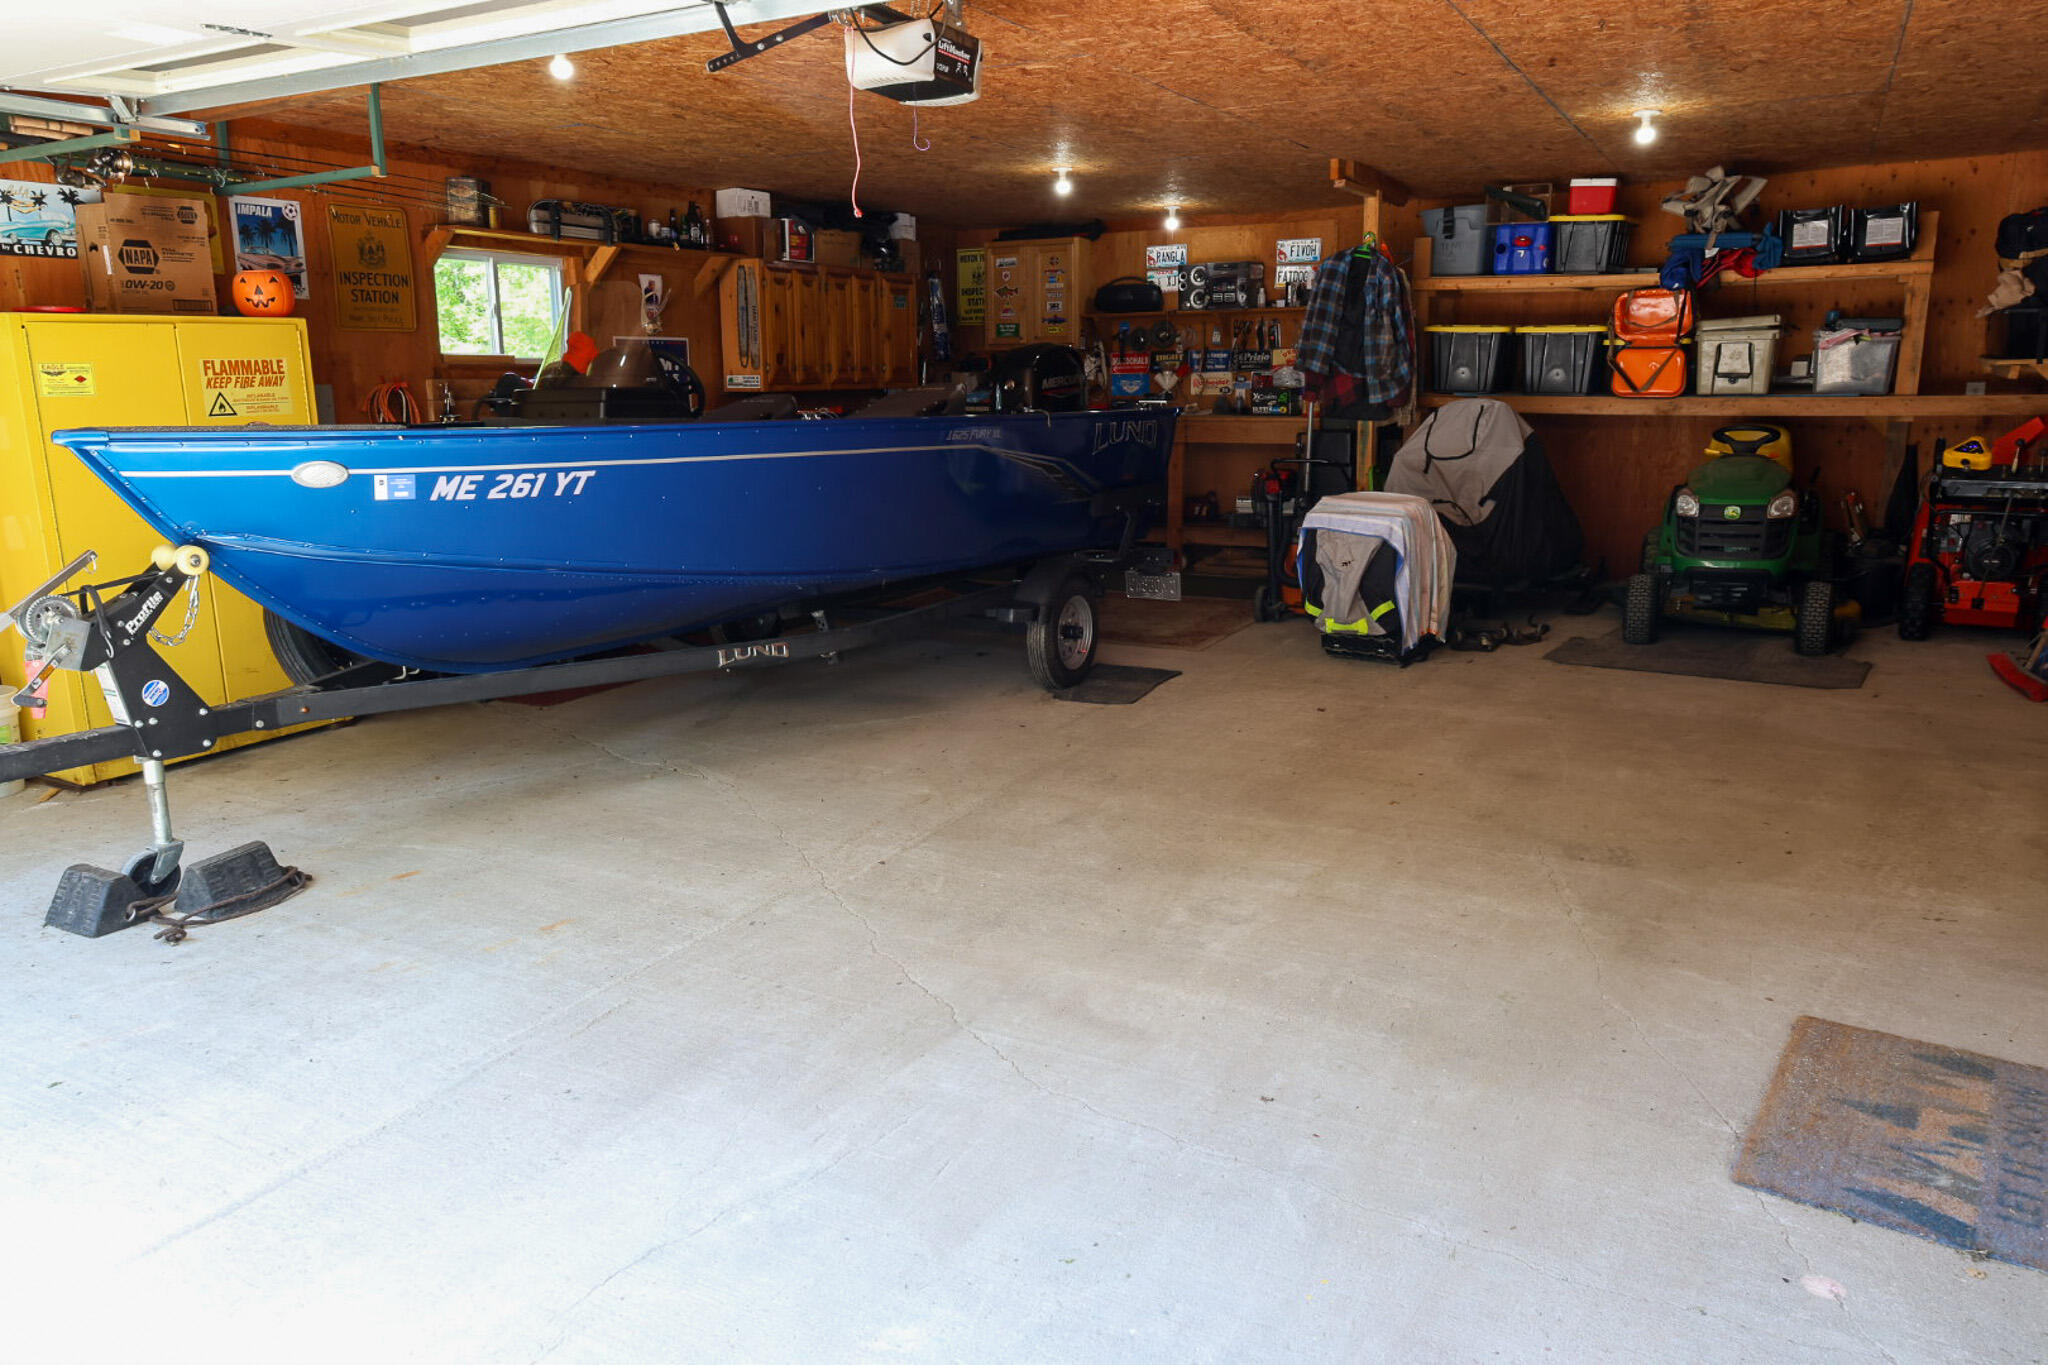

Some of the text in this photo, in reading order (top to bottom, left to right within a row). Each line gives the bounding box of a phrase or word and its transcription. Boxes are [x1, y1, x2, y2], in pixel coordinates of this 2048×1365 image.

[237, 204, 272, 217] IMPALA
[363, 212, 402, 228] VEHICLE
[13, 244, 77, 256] CHEVRO
[124, 248, 153, 265] NAPA
[125, 280, 163, 291] 0W-20
[340, 271, 408, 288] INSPECTION
[351, 289, 399, 304] STATION
[203, 359, 285, 376] FLAMMABLE
[206, 375, 285, 389] KEEP FIRE AWAY
[1092, 420, 1158, 456] LUND
[429, 475, 485, 501] ME
[487, 473, 547, 499] 261
[554, 470, 597, 497] YT
[717, 642, 790, 668] LUND
